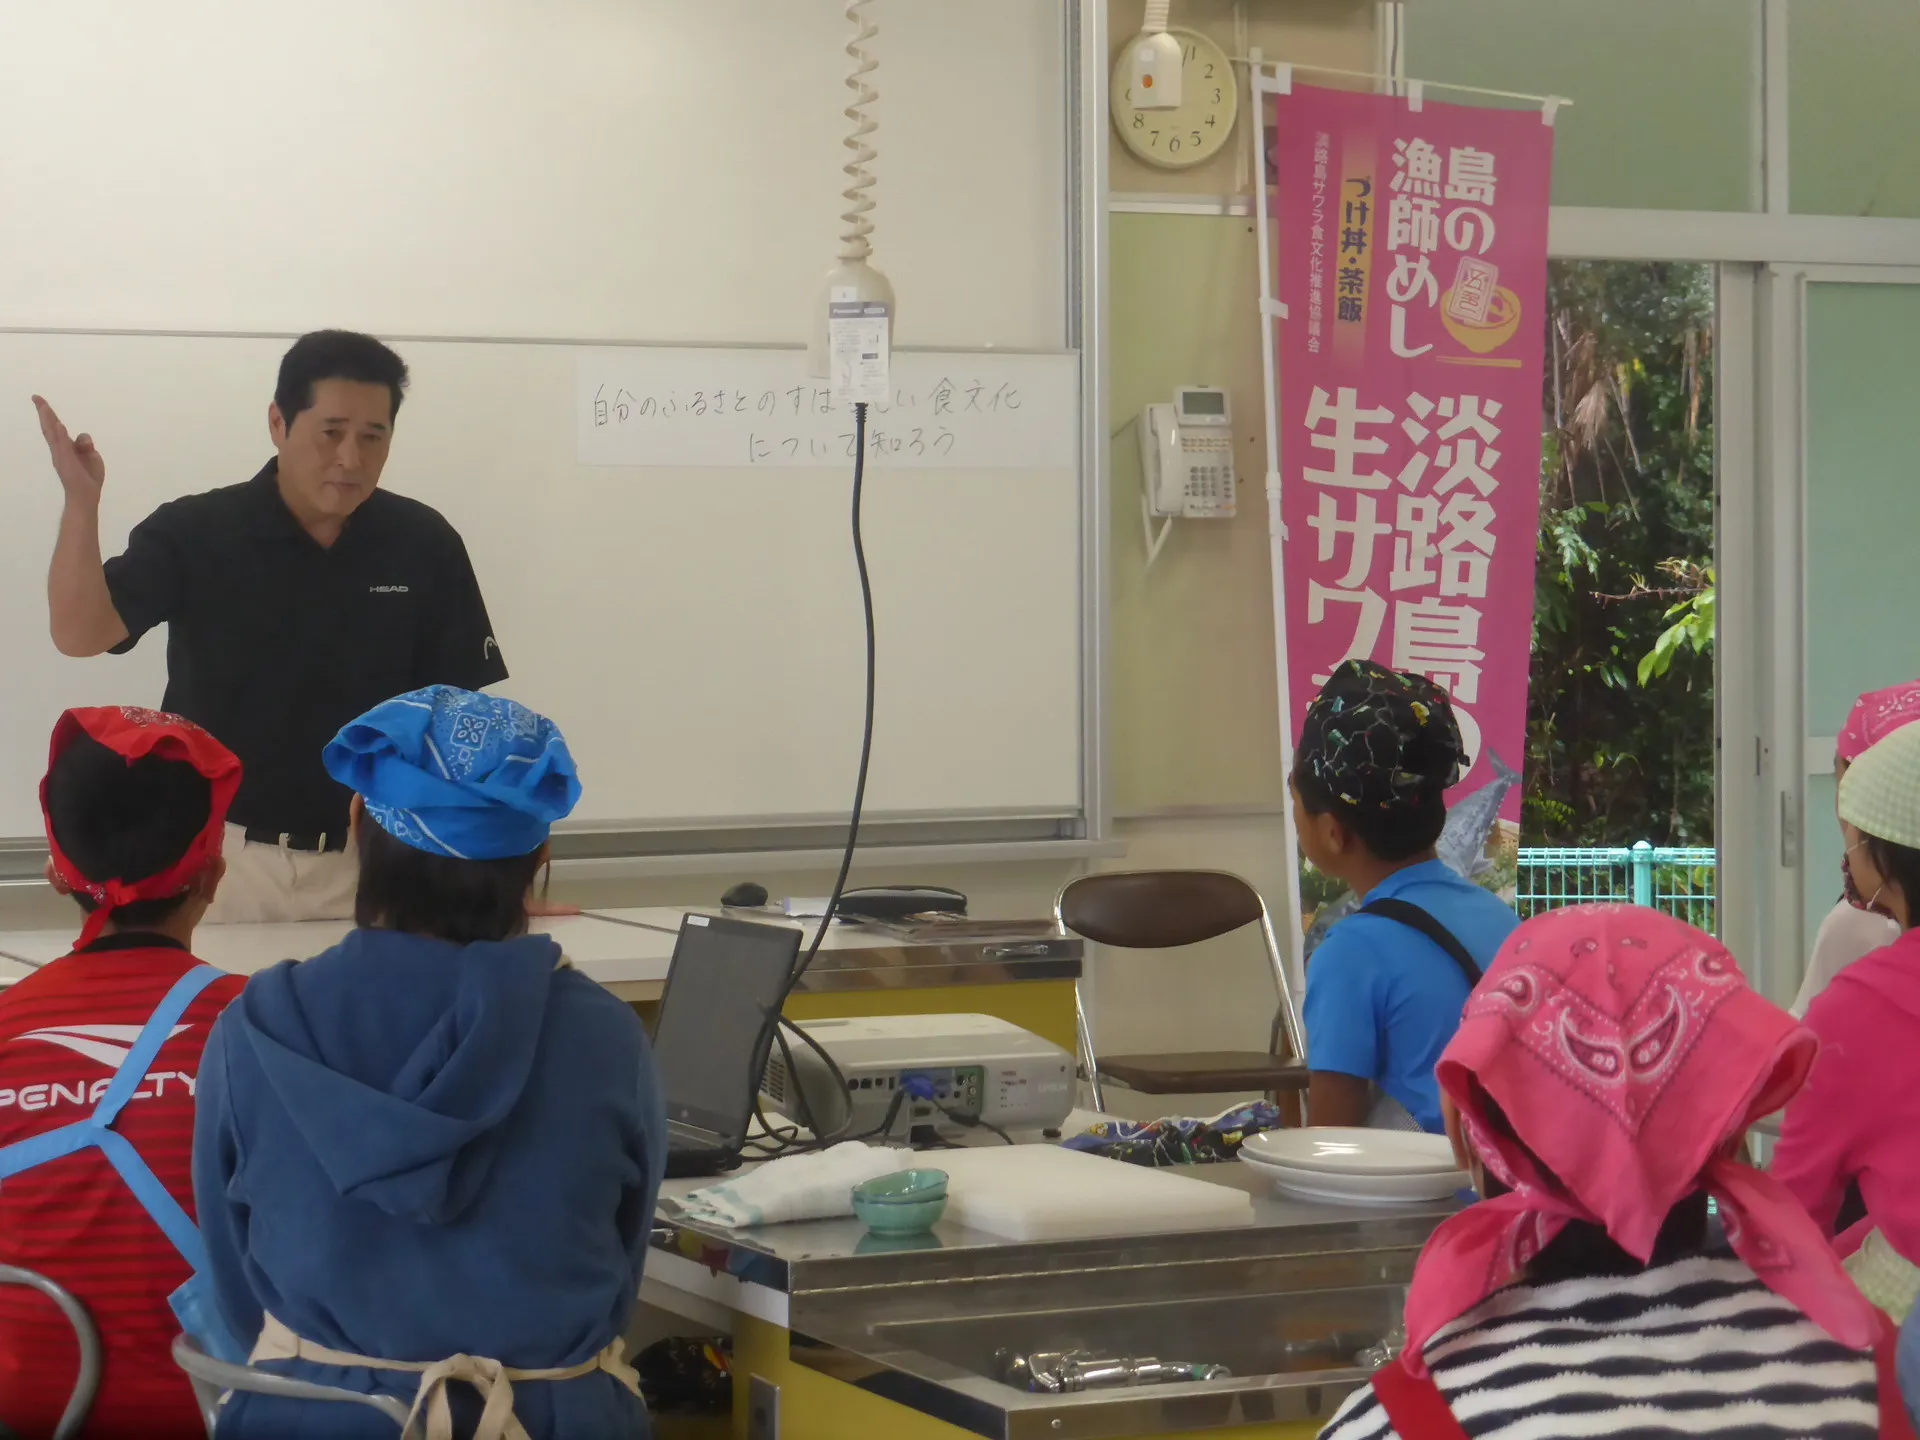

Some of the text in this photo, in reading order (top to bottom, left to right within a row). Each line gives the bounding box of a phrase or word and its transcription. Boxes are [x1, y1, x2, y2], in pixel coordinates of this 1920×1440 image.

[1204, 64, 1214, 79] 2
[1211, 88, 1221, 104] 3
[1133, 113, 1145, 129] 8
[1204, 114, 1216, 128] 4
[1150, 131, 1160, 147] 7
[1169, 135, 1181, 152] 6
[1189, 131, 1202, 147] 5
[1444, 146, 1498, 255] 島の
[1386, 137, 1443, 359] 漁師めし
[749, 426, 956, 463] について知ろう
[1302, 385, 1396, 712] 生サワ
[369, 585, 409, 593] HEAD
